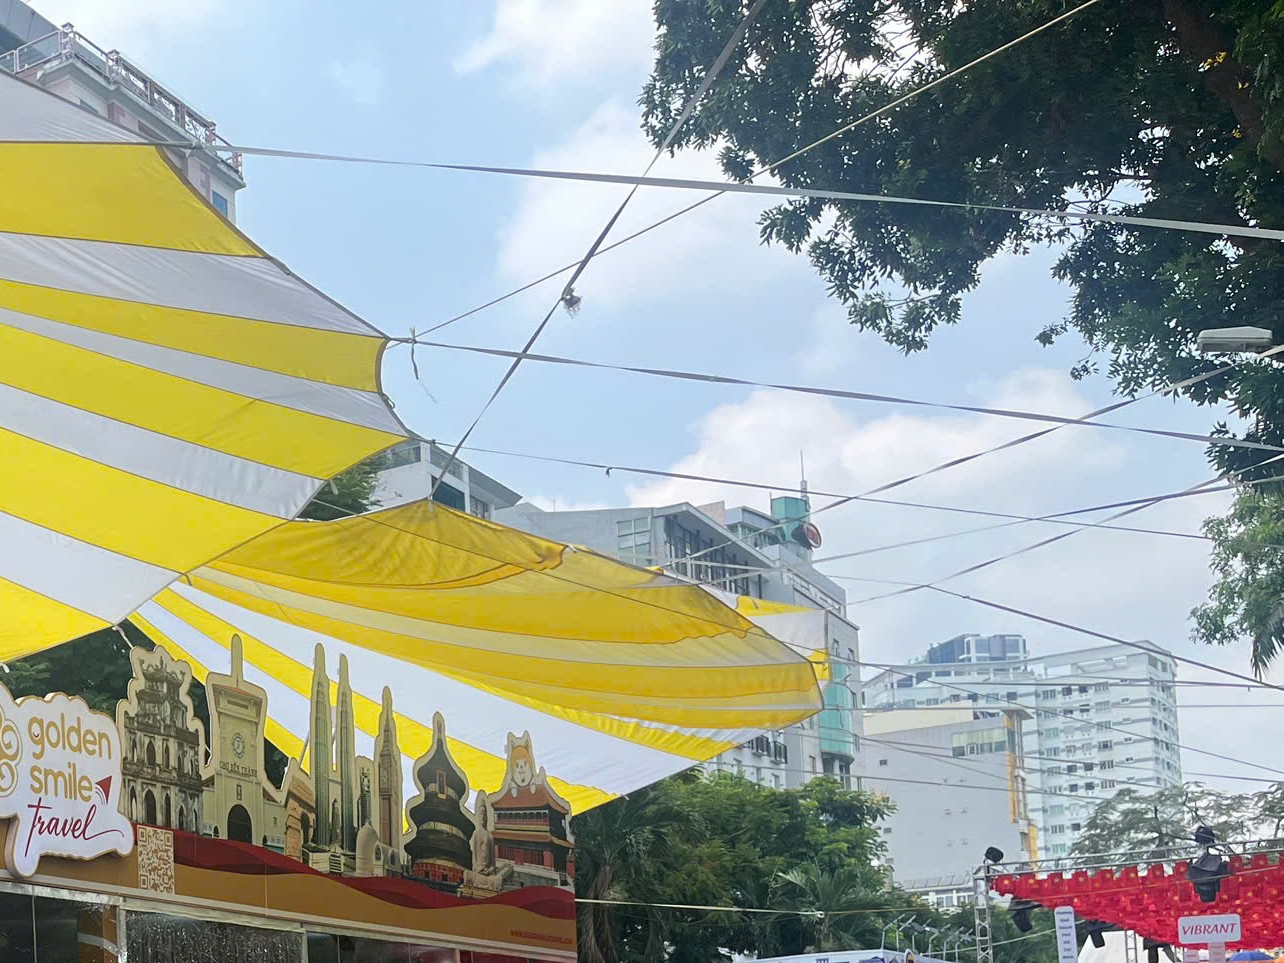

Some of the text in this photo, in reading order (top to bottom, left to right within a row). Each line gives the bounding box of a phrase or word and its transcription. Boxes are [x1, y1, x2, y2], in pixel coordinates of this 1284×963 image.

[28, 713, 112, 760] golden
[29, 761, 93, 802] smile
[1182, 923, 1236, 935] VIBRANT
